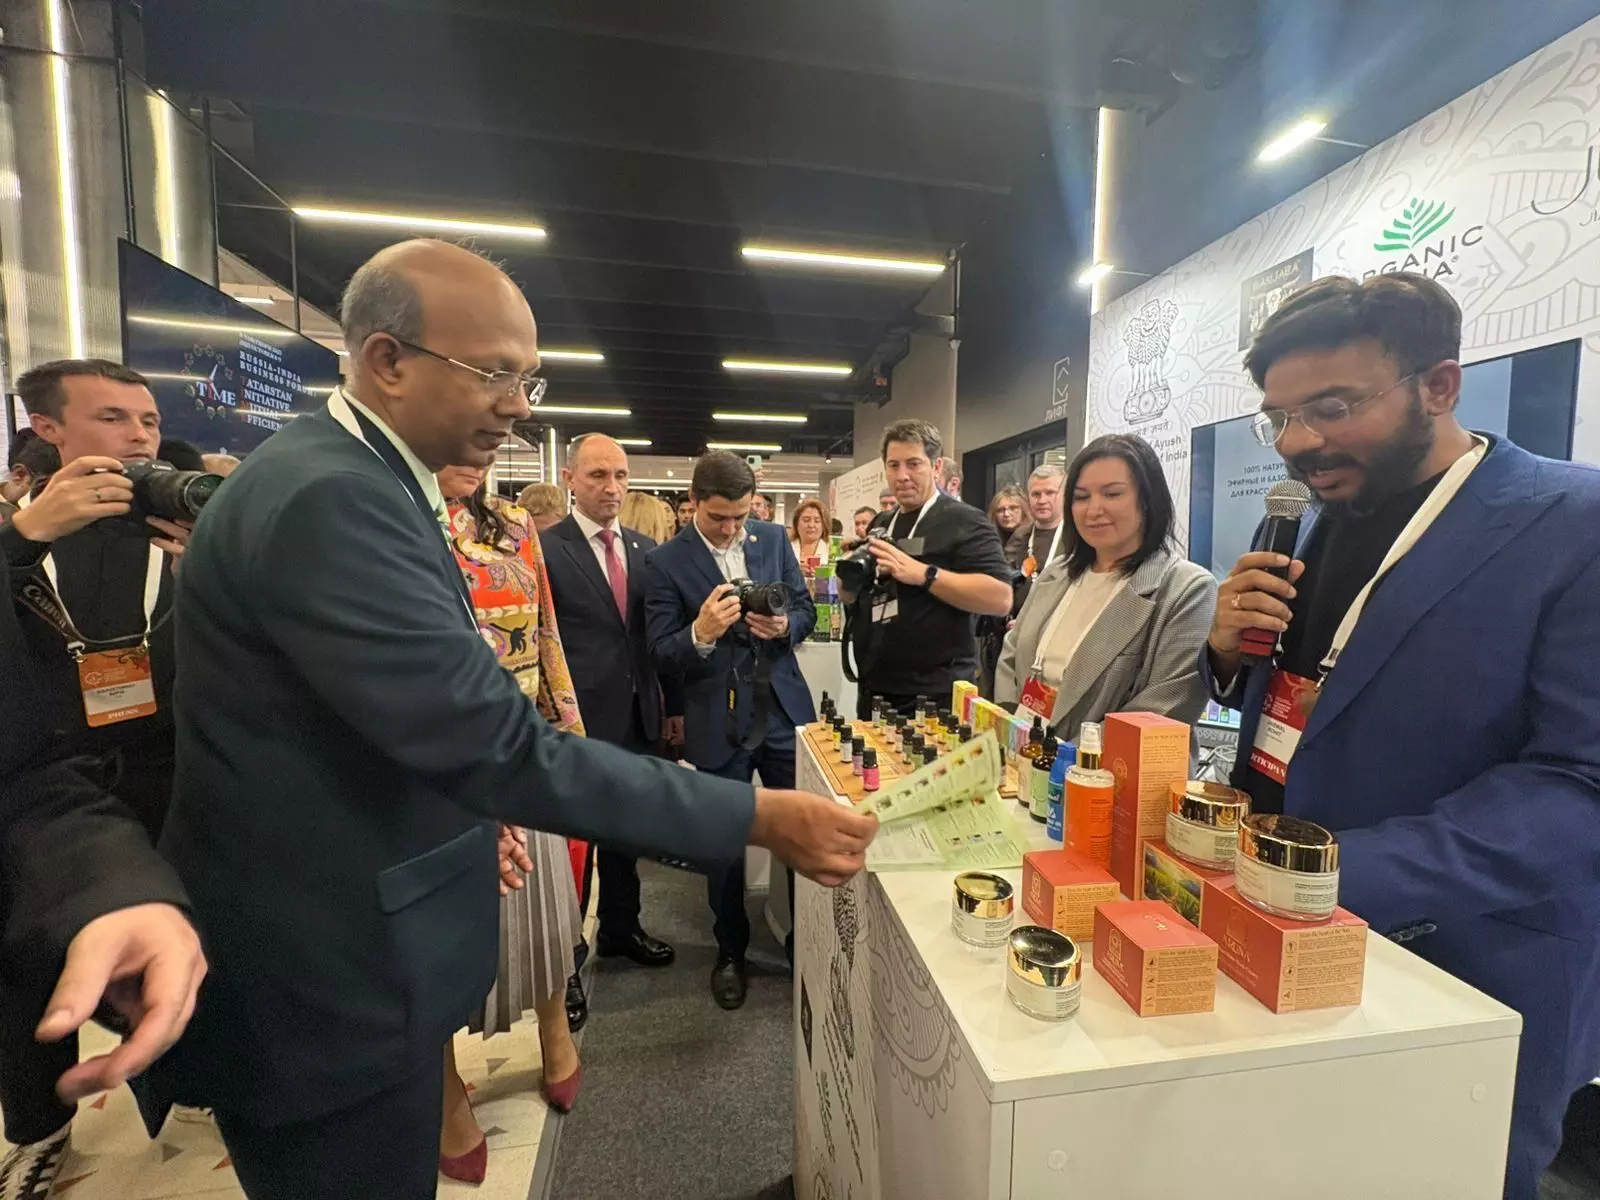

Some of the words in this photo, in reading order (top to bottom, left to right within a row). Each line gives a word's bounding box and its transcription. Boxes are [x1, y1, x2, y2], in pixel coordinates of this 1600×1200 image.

[240, 350, 302, 383] RUSSIA-INDIA
[240, 361, 285, 385] BUSINESS
[196, 381, 236, 407] TIME
[240, 376, 293, 403] TATARSTAN
[240, 389, 291, 413] INITIATIVE
[1154, 435, 1182, 450] Ayush
[1165, 449, 1188, 463] India
[1230, 490, 1244, 498] ДЛЯ
[23, 584, 67, 629] Canon
